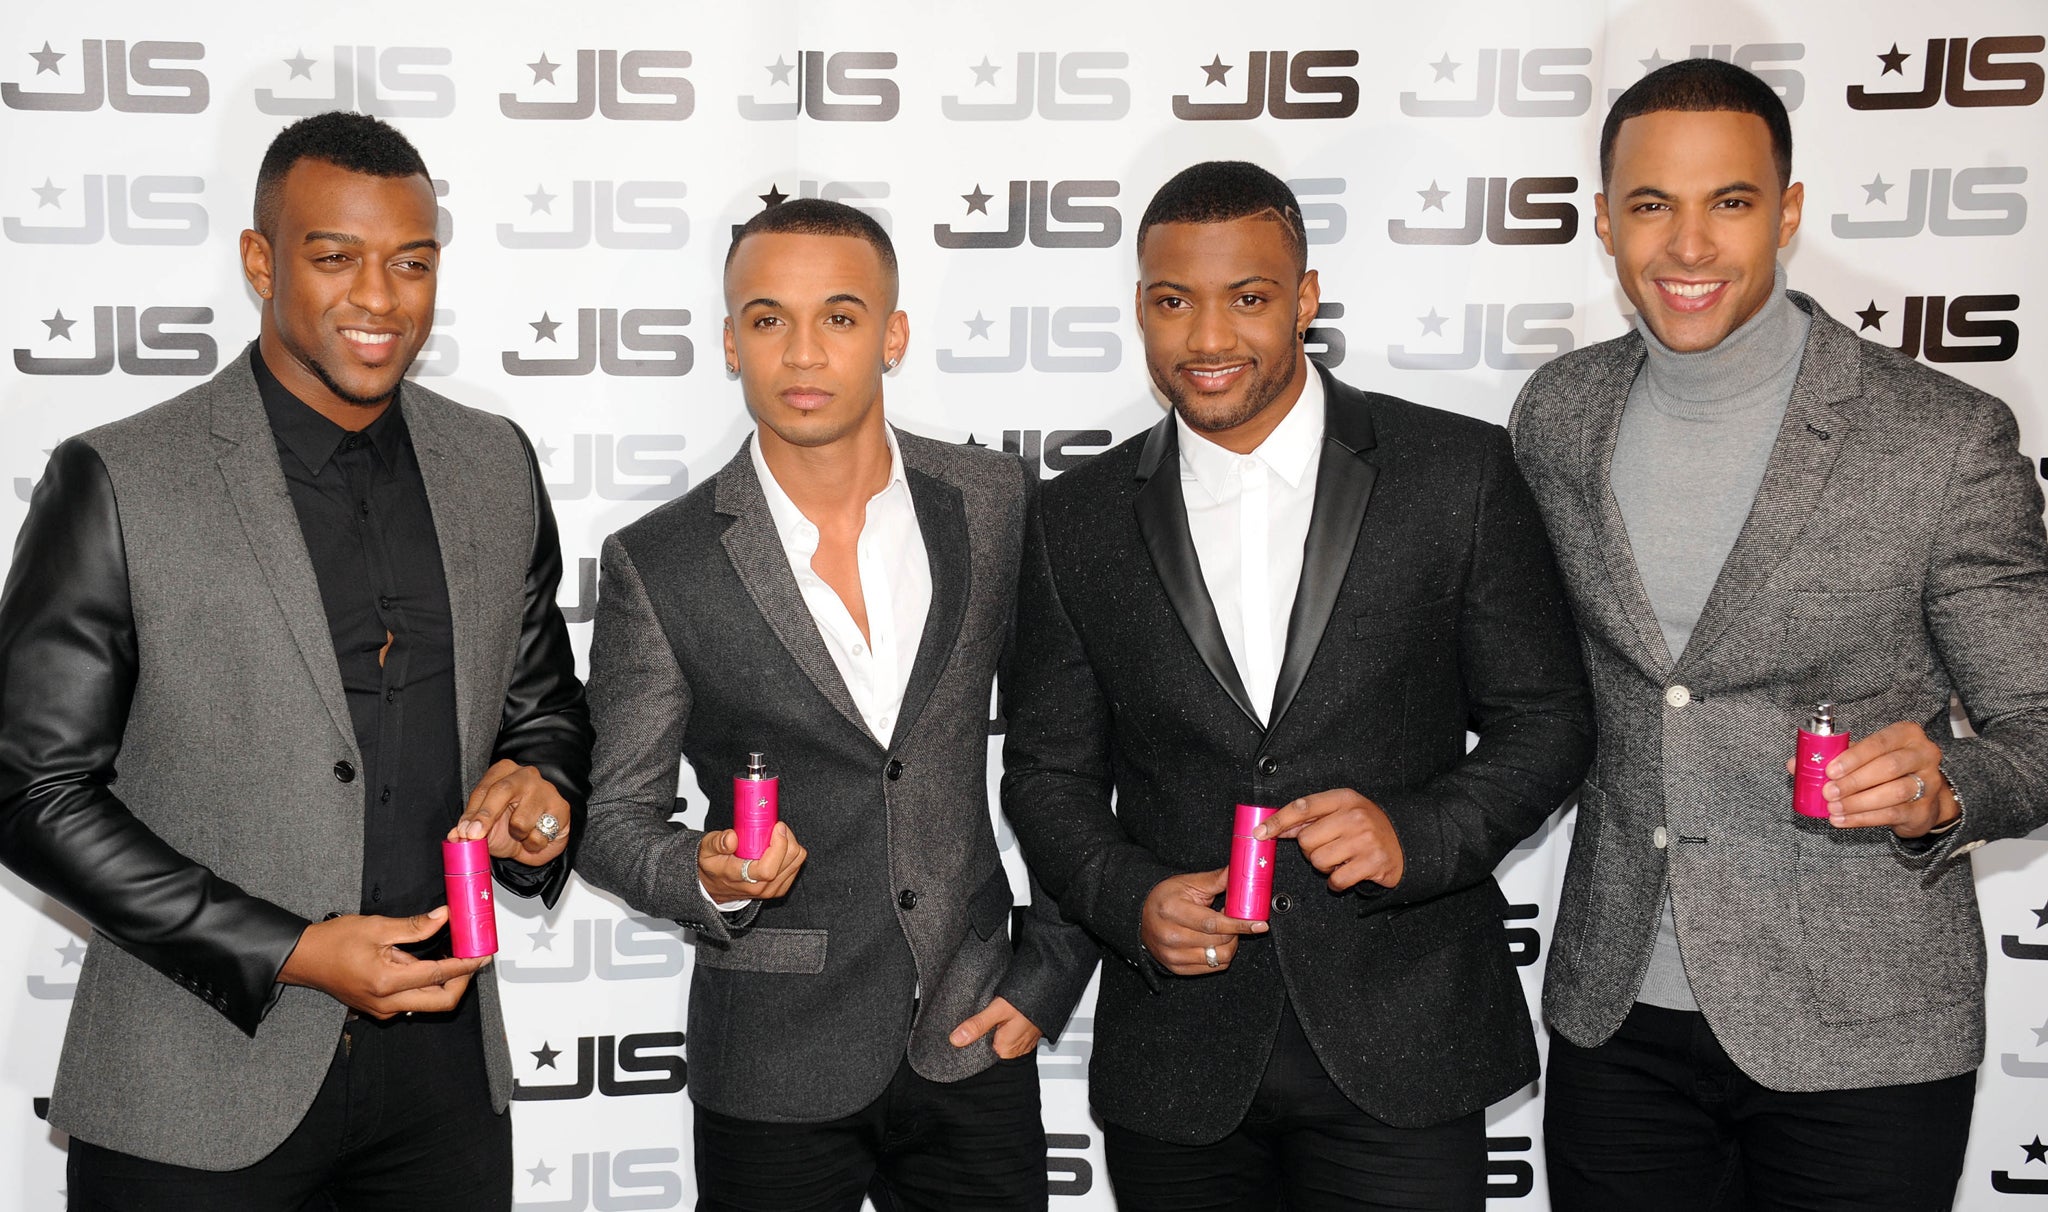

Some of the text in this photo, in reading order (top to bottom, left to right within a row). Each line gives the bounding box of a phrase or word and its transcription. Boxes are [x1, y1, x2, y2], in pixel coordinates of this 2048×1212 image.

[1, 39, 210, 114] JLS
[254, 45, 456, 118] JLS
[499, 49, 695, 121] JLS
[737, 50, 900, 122] JLS
[942, 51, 1131, 121] JLS
[1172, 49, 1360, 121] JLS
[1399, 48, 1592, 118] JLS
[1846, 35, 2046, 111] JLS
[3, 174, 209, 246] JLS
[496, 180, 690, 250] JLS
[934, 180, 1122, 249] JLS
[1388, 176, 1579, 246] JLS
[1831, 166, 2028, 240] JLS
[13, 306, 218, 376] JLS
[501, 307, 695, 377] JLS
[935, 306, 1122, 373] JLS
[1387, 302, 1575, 370] JLS
[499, 917, 685, 984] JLS
[512, 1031, 688, 1101] JLS
